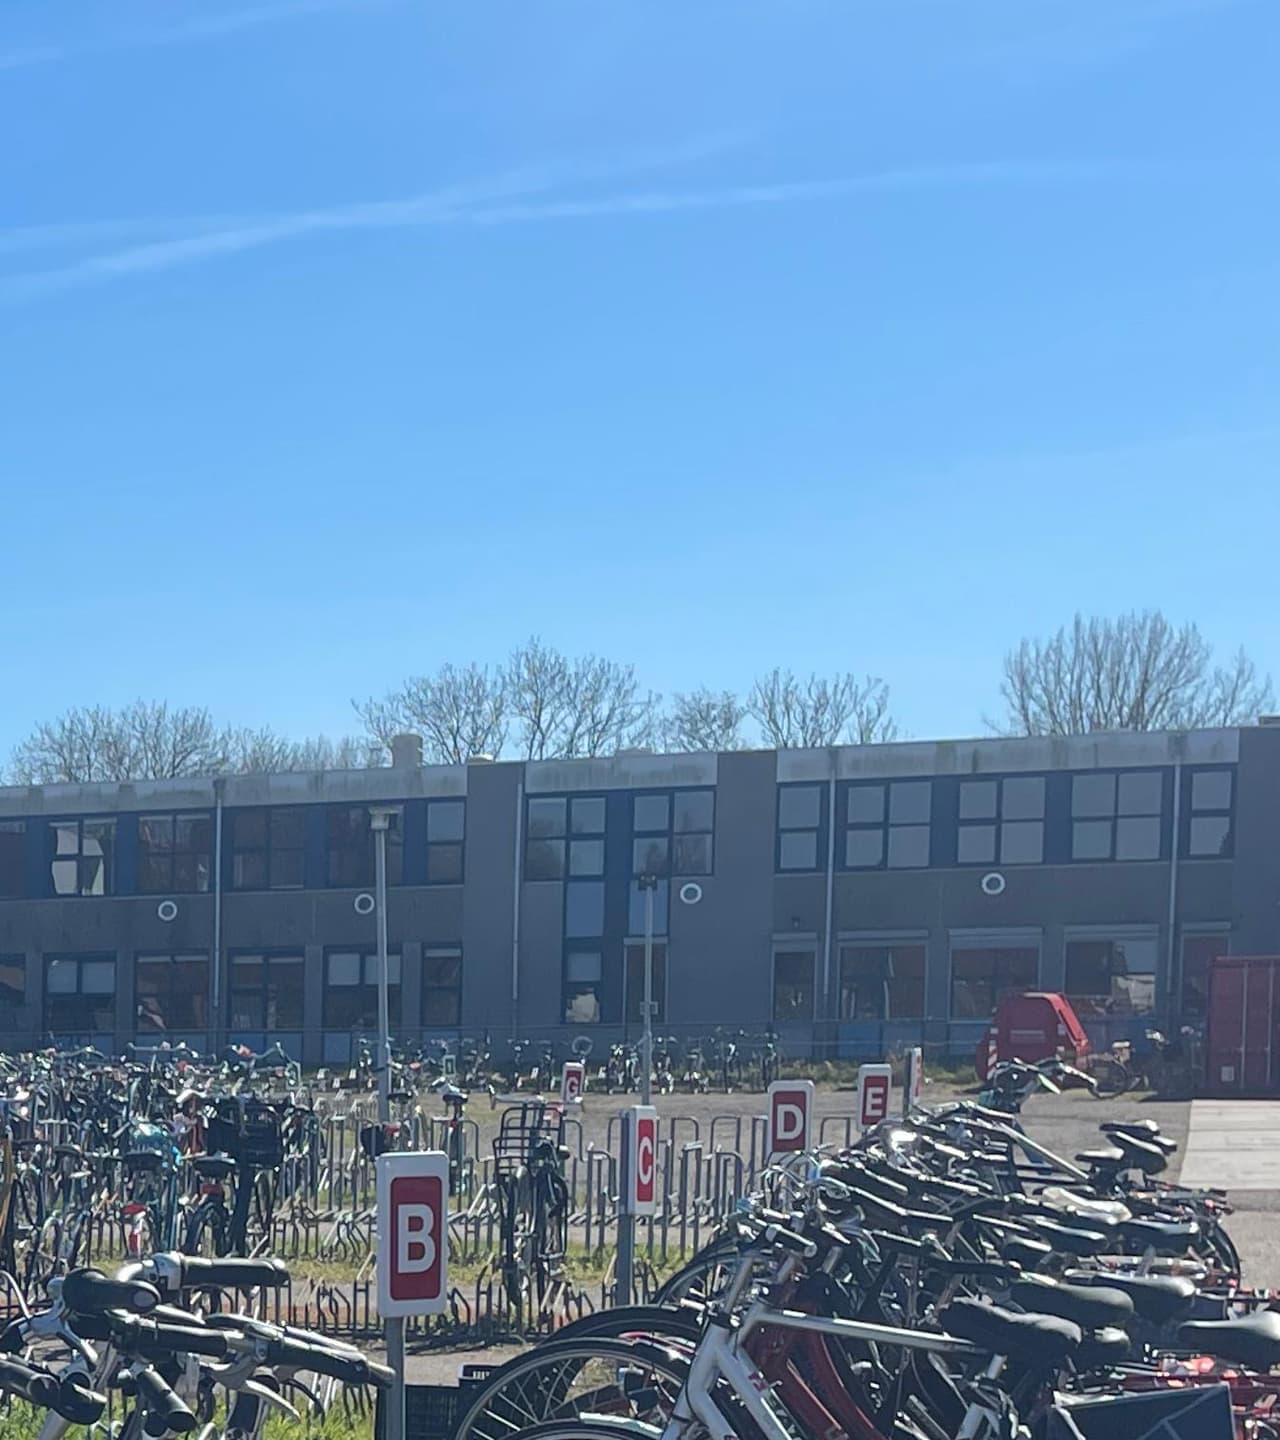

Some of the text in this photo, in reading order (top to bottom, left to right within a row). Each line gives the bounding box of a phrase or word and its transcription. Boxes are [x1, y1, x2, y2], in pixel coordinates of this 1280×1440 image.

[567, 1077, 579, 1095] G
[865, 1087, 883, 1116] E
[776, 1104, 803, 1140] D
[639, 1136, 652, 1185] C
[398, 1204, 435, 1273] B
